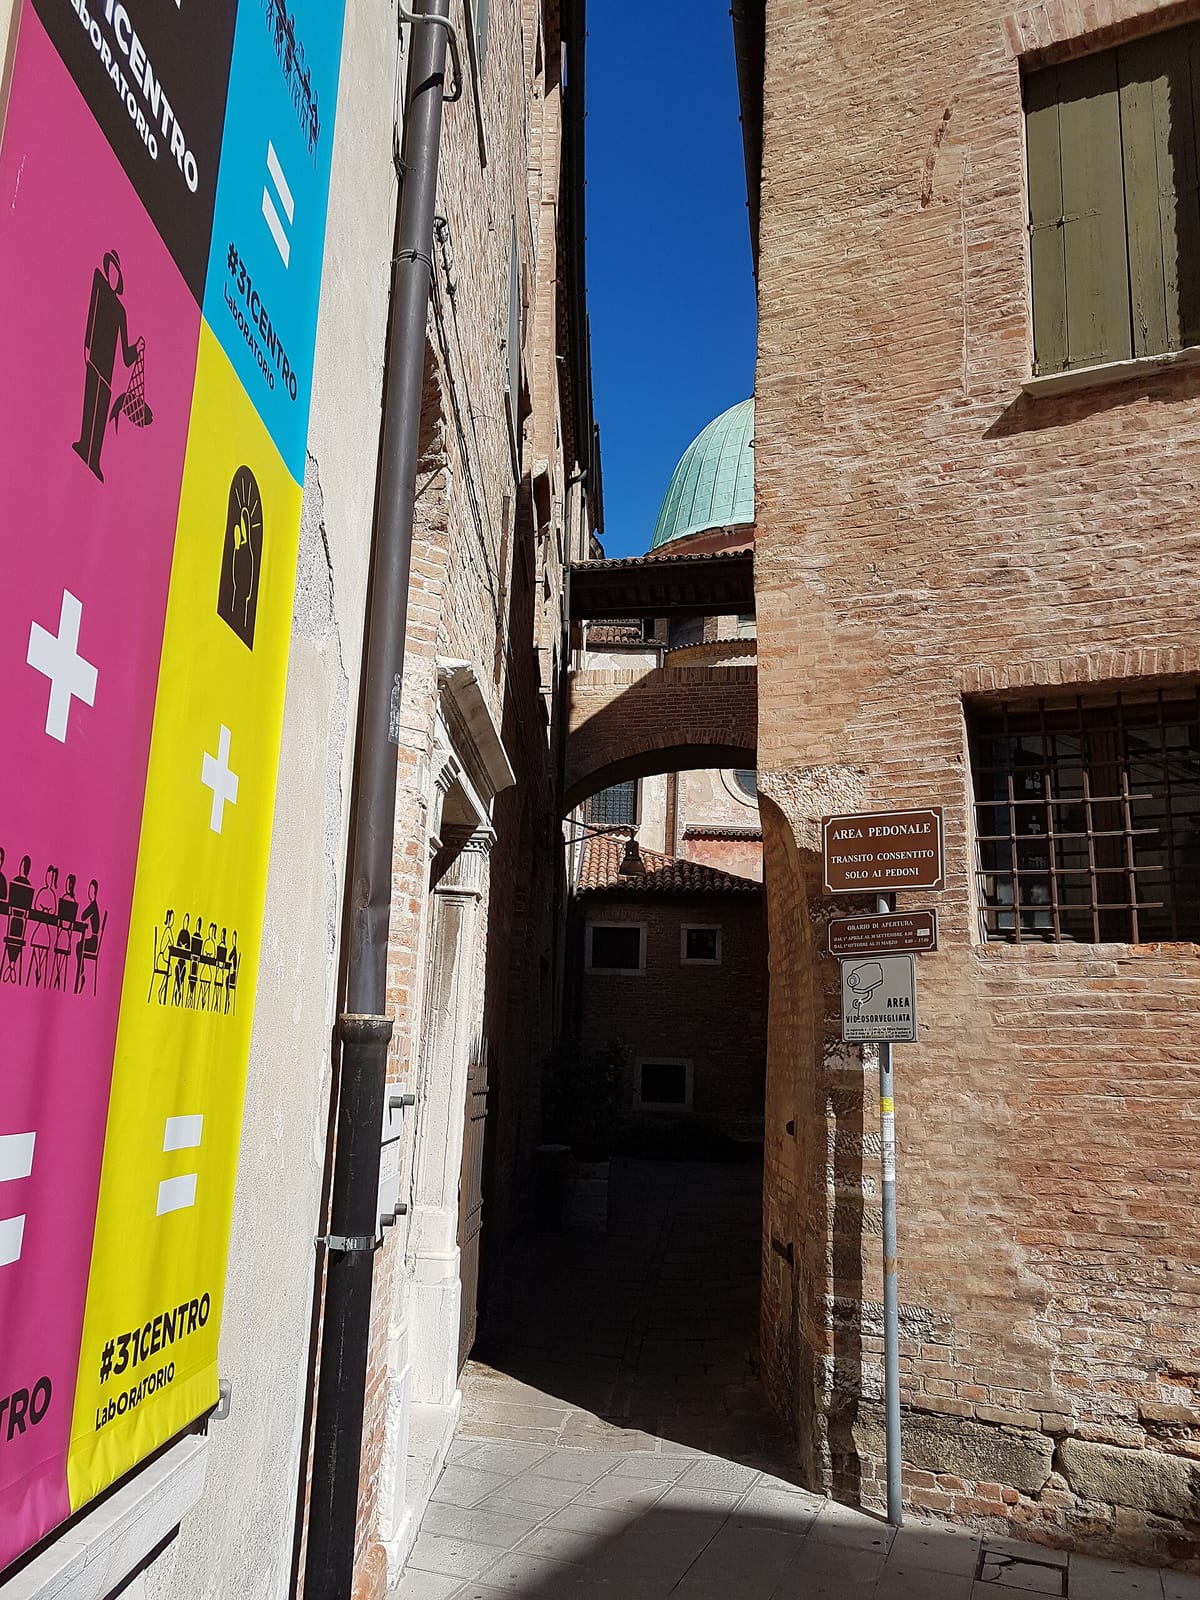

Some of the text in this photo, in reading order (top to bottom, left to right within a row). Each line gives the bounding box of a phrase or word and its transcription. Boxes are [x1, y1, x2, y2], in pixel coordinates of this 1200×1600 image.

[227, 242, 298, 401] #31CENTRO
[223, 281, 275, 391] LabORATORIO
[832, 823, 931, 840] AREA PEDONALE
[831, 849, 934, 864] TRANSITO CONSENTITO
[845, 867, 919, 880] SOLO AI PEDONI
[847, 923, 870, 931] ORARIO
[881, 920, 913, 929] APERTURA
[887, 997, 910, 1008] AREA
[845, 1014, 911, 1023] VIDEOSORVEGLIATA
[99, 1292, 211, 1385] #31CENTRO
[95, 1362, 175, 1432] LabORATORIO
